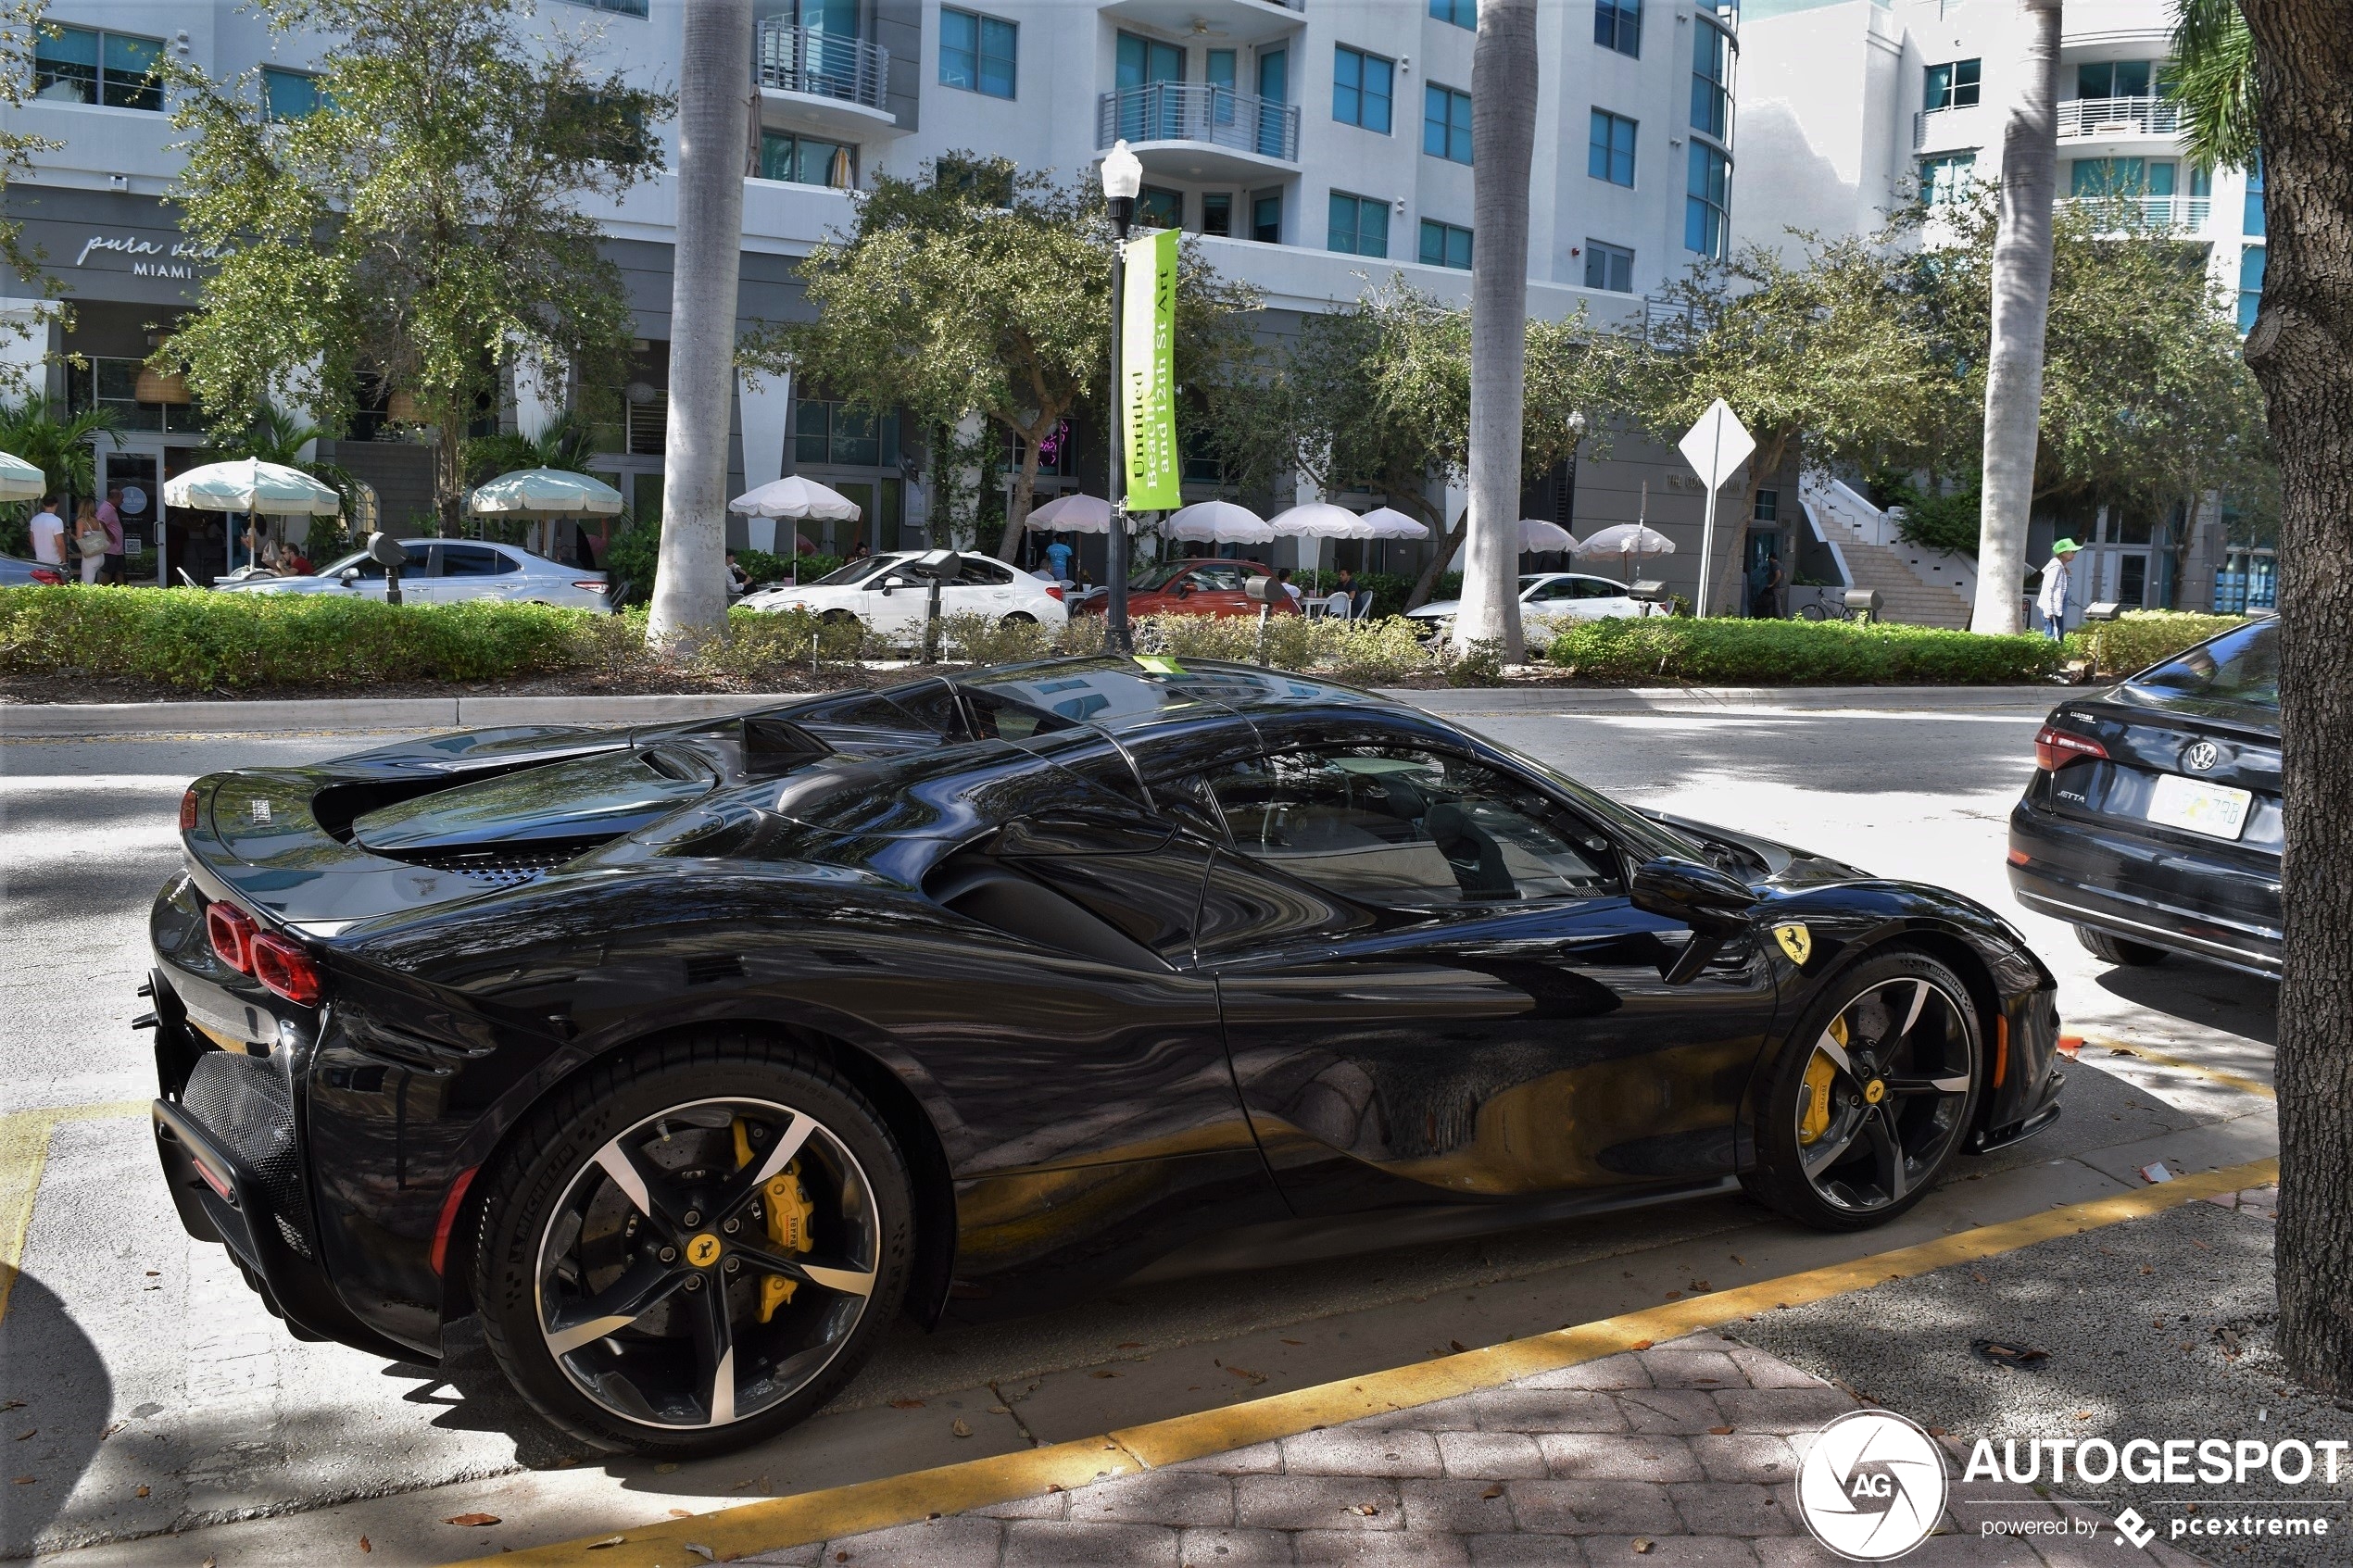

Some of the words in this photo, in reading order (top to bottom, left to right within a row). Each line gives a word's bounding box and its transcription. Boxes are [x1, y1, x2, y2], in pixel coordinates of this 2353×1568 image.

[76, 236, 163, 266] pura
[133, 262, 192, 279] MIAMI
[1158, 269, 1169, 313] Art
[1156, 320, 1167, 348] St
[1156, 358, 1167, 414] 12th
[1132, 372, 1145, 480] Untitled
[1157, 420, 1170, 473] and
[2057, 790, 2085, 803] JETTA
[1929, 964, 1964, 997] MICHELIN
[515, 1145, 577, 1242] MICHELIN
[790, 1217, 799, 1250] Ferrar
